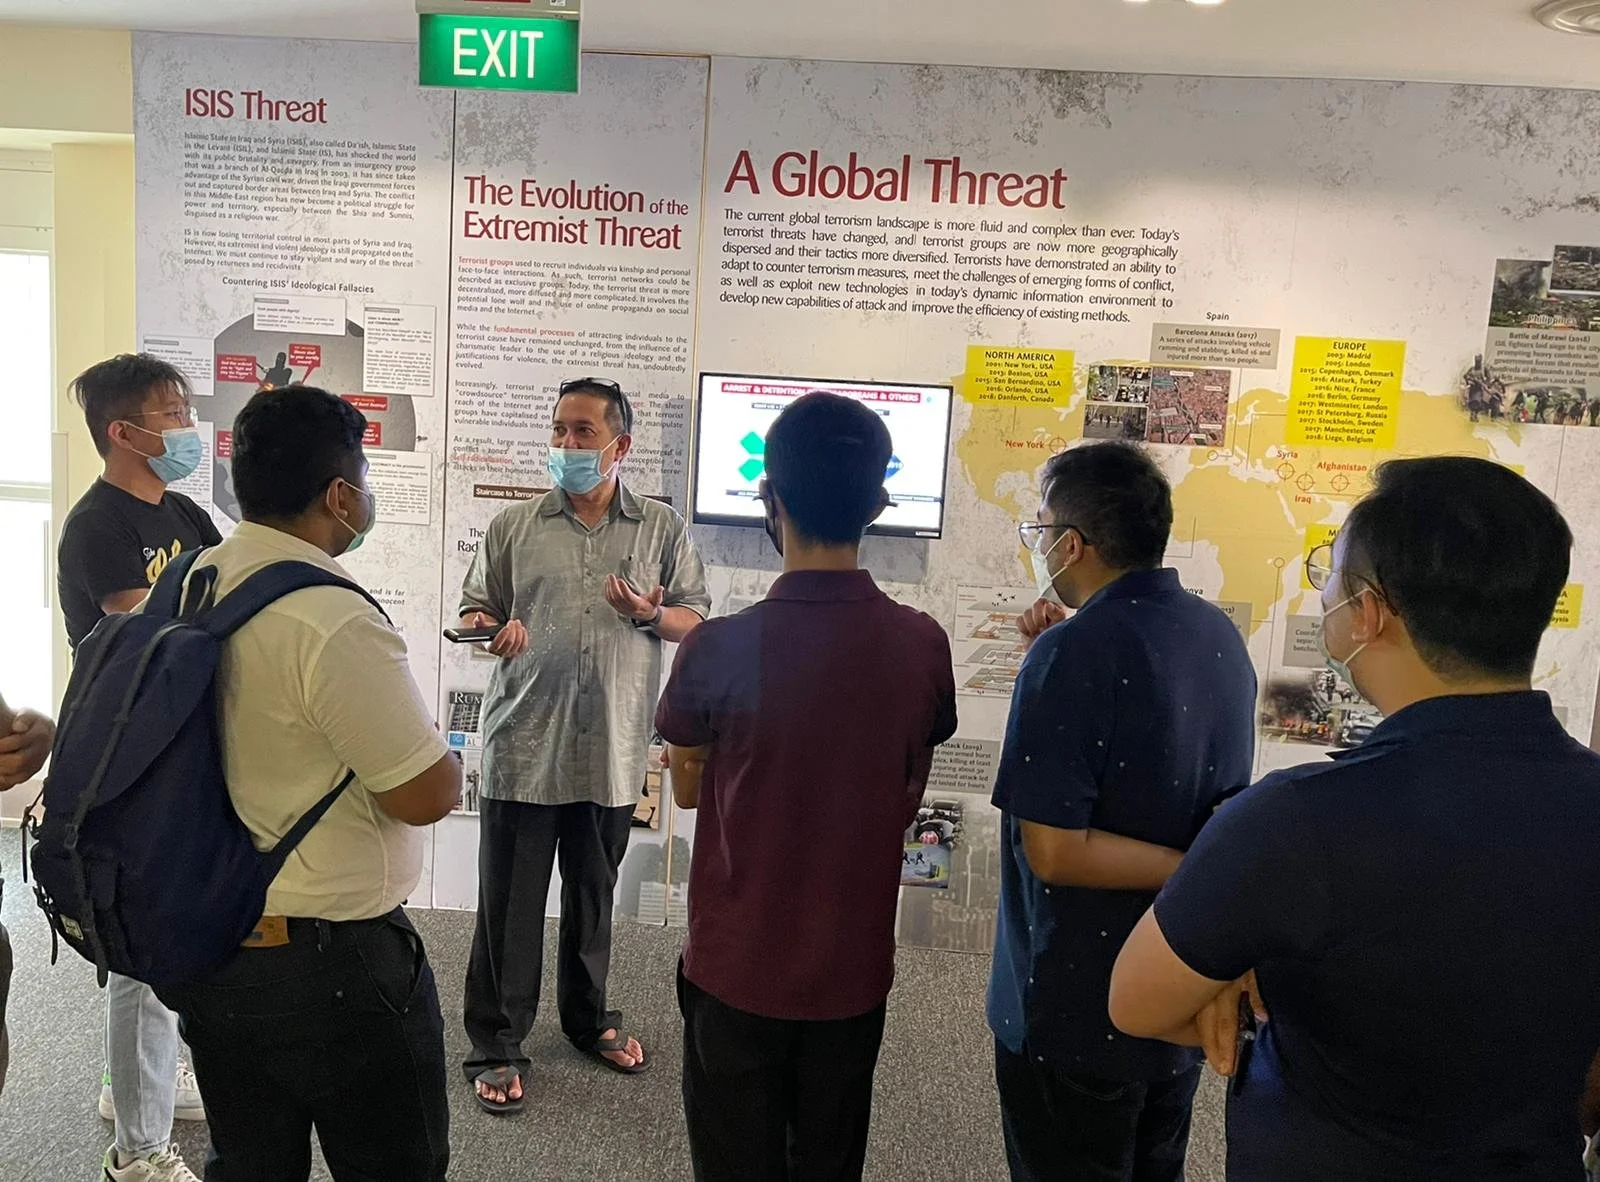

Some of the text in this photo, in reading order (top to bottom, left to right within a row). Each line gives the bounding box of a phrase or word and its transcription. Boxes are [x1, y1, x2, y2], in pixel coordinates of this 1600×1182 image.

[454, 28, 544, 78] EXIT
[185, 88, 327, 123] ISIS Threat
[724, 150, 1067, 209] A Global Threat
[464, 176, 688, 215] The Evolution of the
[464, 211, 682, 250] Extremist Threat
[724, 208, 743, 220] The
[747, 211, 784, 222] current
[789, 212, 820, 226] global
[825, 213, 872, 226] terrorism
[877, 215, 929, 232] landscape
[934, 218, 943, 229] is
[947, 222, 975, 231] more
[980, 220, 1003, 232] fluid
[1007, 222, 1027, 233] and
[1032, 224, 1077, 238] complex
[1082, 225, 1106, 237] than
[1110, 229, 1135, 238] ever.
[184, 228, 192, 236] IS
[219, 230, 240, 241] losing
[241, 231, 275, 240] territorial
[276, 234, 301, 242] control
[333, 237, 350, 246] parts
[362, 238, 381, 248] Syria
[383, 239, 396, 247] and
[723, 225, 1178, 261] terrorist threats have changed, and terrorist groups are now more geographically
[458, 256, 691, 277] Terrorist groups used to recruit individuals via kinship and personal
[722, 242, 1176, 277] dispersed and their tactics more diversified. Terrorists have demonstrated an ability to
[721, 258, 1175, 292] adapt to counter terrorism measures, meet the challenges of emerging forms of conflict,
[223, 277, 268, 288] Countering
[291, 281, 336, 292] Ideological
[339, 282, 374, 293] Fallacies
[720, 277, 732, 286] as
[737, 276, 758, 287] well
[762, 279, 774, 288] as
[779, 278, 813, 292] exploit
[818, 282, 840, 291] new
[846, 280, 908, 297] technologies
[915, 284, 926, 295] in
[973, 287, 1017, 301] dynamic
[1022, 289, 1083, 303] information
[1089, 293, 1156, 306] environment
[1162, 296, 1173, 307] to
[719, 290, 1130, 323] develop new capabilities of attack and improve the efficiency of existing methods.
[1206, 312, 1229, 321] Spain
[1333, 342, 1366, 351] EUROPE
[985, 351, 1055, 361] NORTH AMERICA
[1319, 368, 1362, 376] Copenhagen,
[890, 393, 919, 402] OTHERS
[998, 394, 1028, 402] Danforth,
[1006, 440, 1023, 448] New
[1277, 450, 1298, 459] Syria
[1317, 462, 1367, 471] Afghanistan
[476, 488, 504, 496] Staircase
[1295, 495, 1311, 504] Iraq
[469, 528, 485, 538] The
